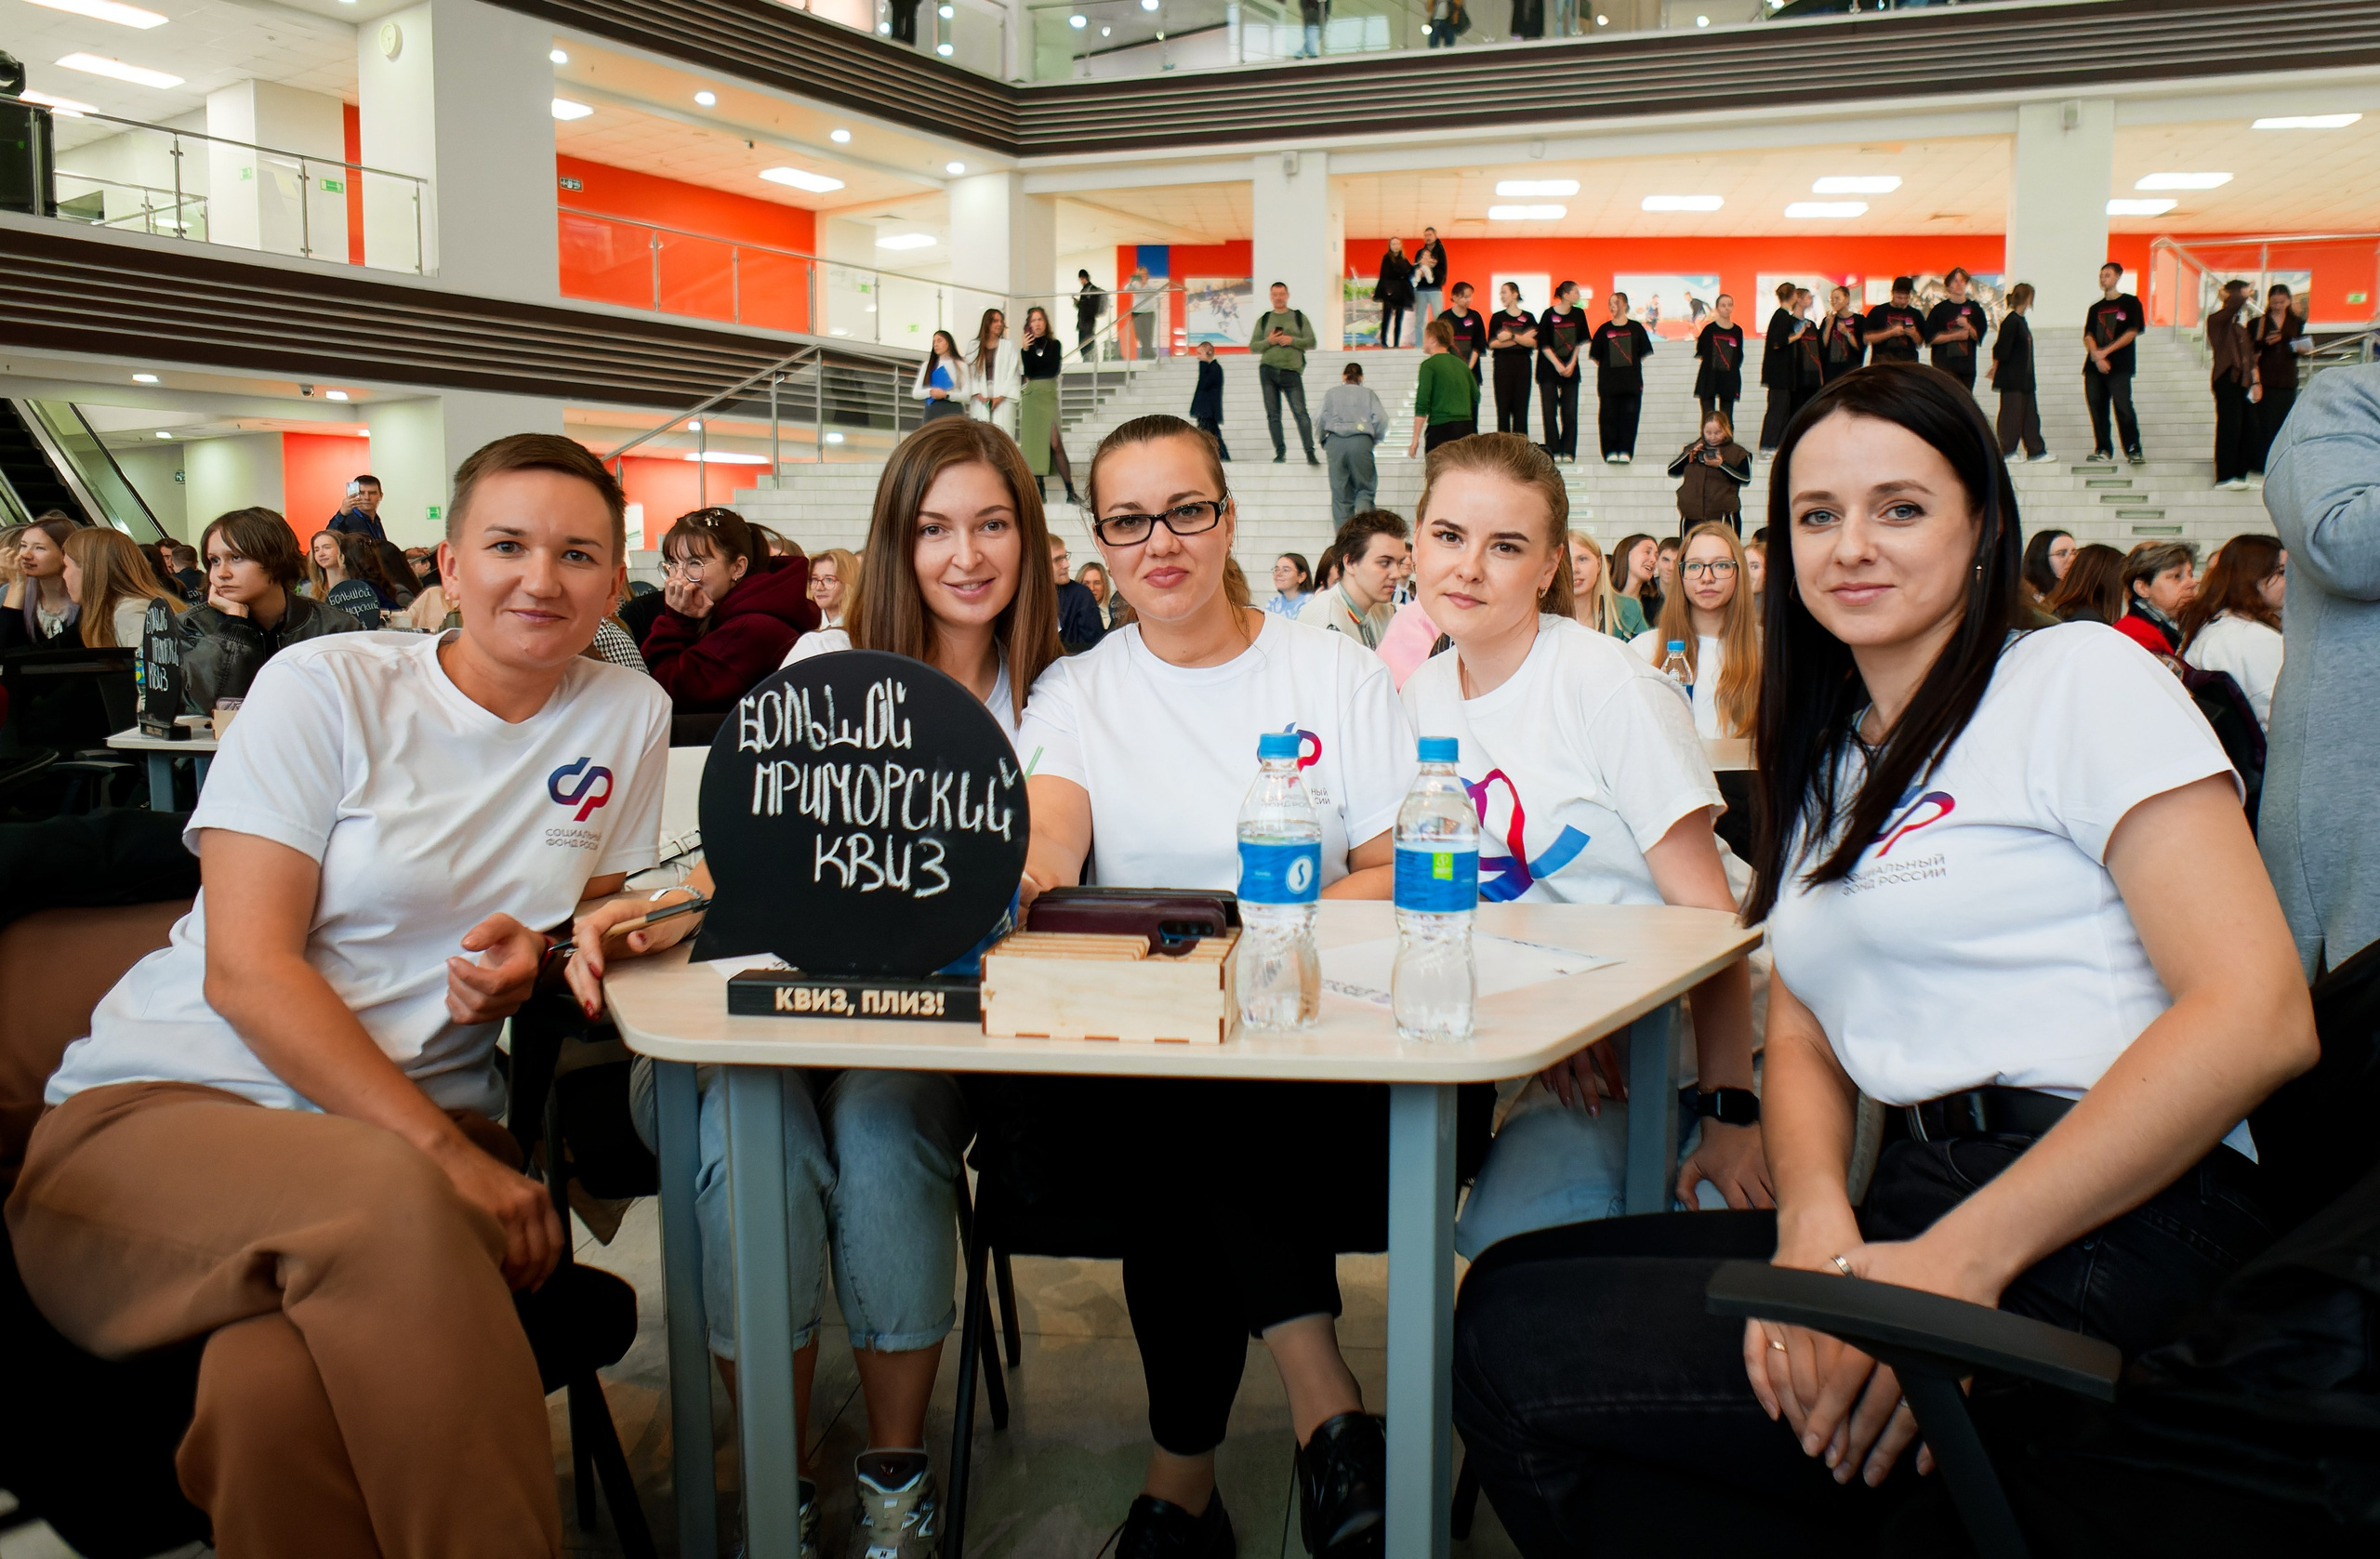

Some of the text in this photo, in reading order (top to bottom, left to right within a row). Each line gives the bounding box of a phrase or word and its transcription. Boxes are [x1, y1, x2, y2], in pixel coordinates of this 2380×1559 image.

[738, 678, 912, 754] БОЛЬШОЙ
[751, 758, 1018, 842] ПРИМОРСКИЙ
[813, 833, 951, 898] КВИЗ
[1879, 867, 1947, 886] РОССИИ
[774, 986, 946, 1017] КВИЗ, ПЛИЗ!
